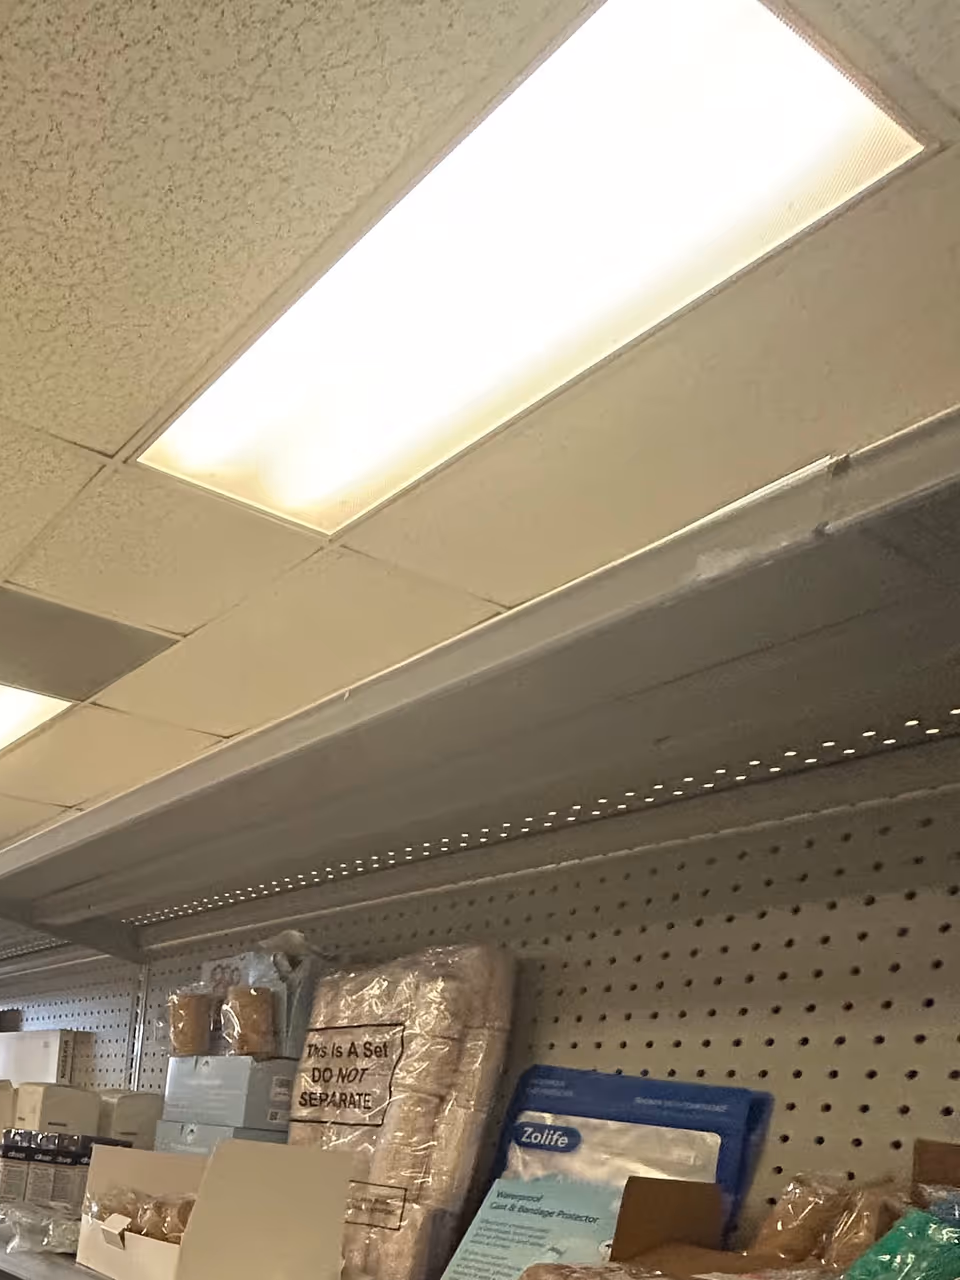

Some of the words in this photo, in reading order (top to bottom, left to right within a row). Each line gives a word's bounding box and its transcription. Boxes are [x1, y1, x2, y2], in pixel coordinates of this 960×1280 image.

[331, 1042, 343, 1057] Is
[347, 1042, 359, 1058] A
[363, 1041, 389, 1058] Set
[312, 1067, 333, 1083] DO
[336, 1067, 369, 1083] NOT
[298, 1091, 372, 1110] SEPARATE
[521, 1126, 569, 1148] Zolife
[496, 1190, 543, 1204] Waterproof
[490, 1202, 508, 1212] Cast
[517, 1204, 555, 1218] Bandage
[555, 1210, 600, 1224] Protector
